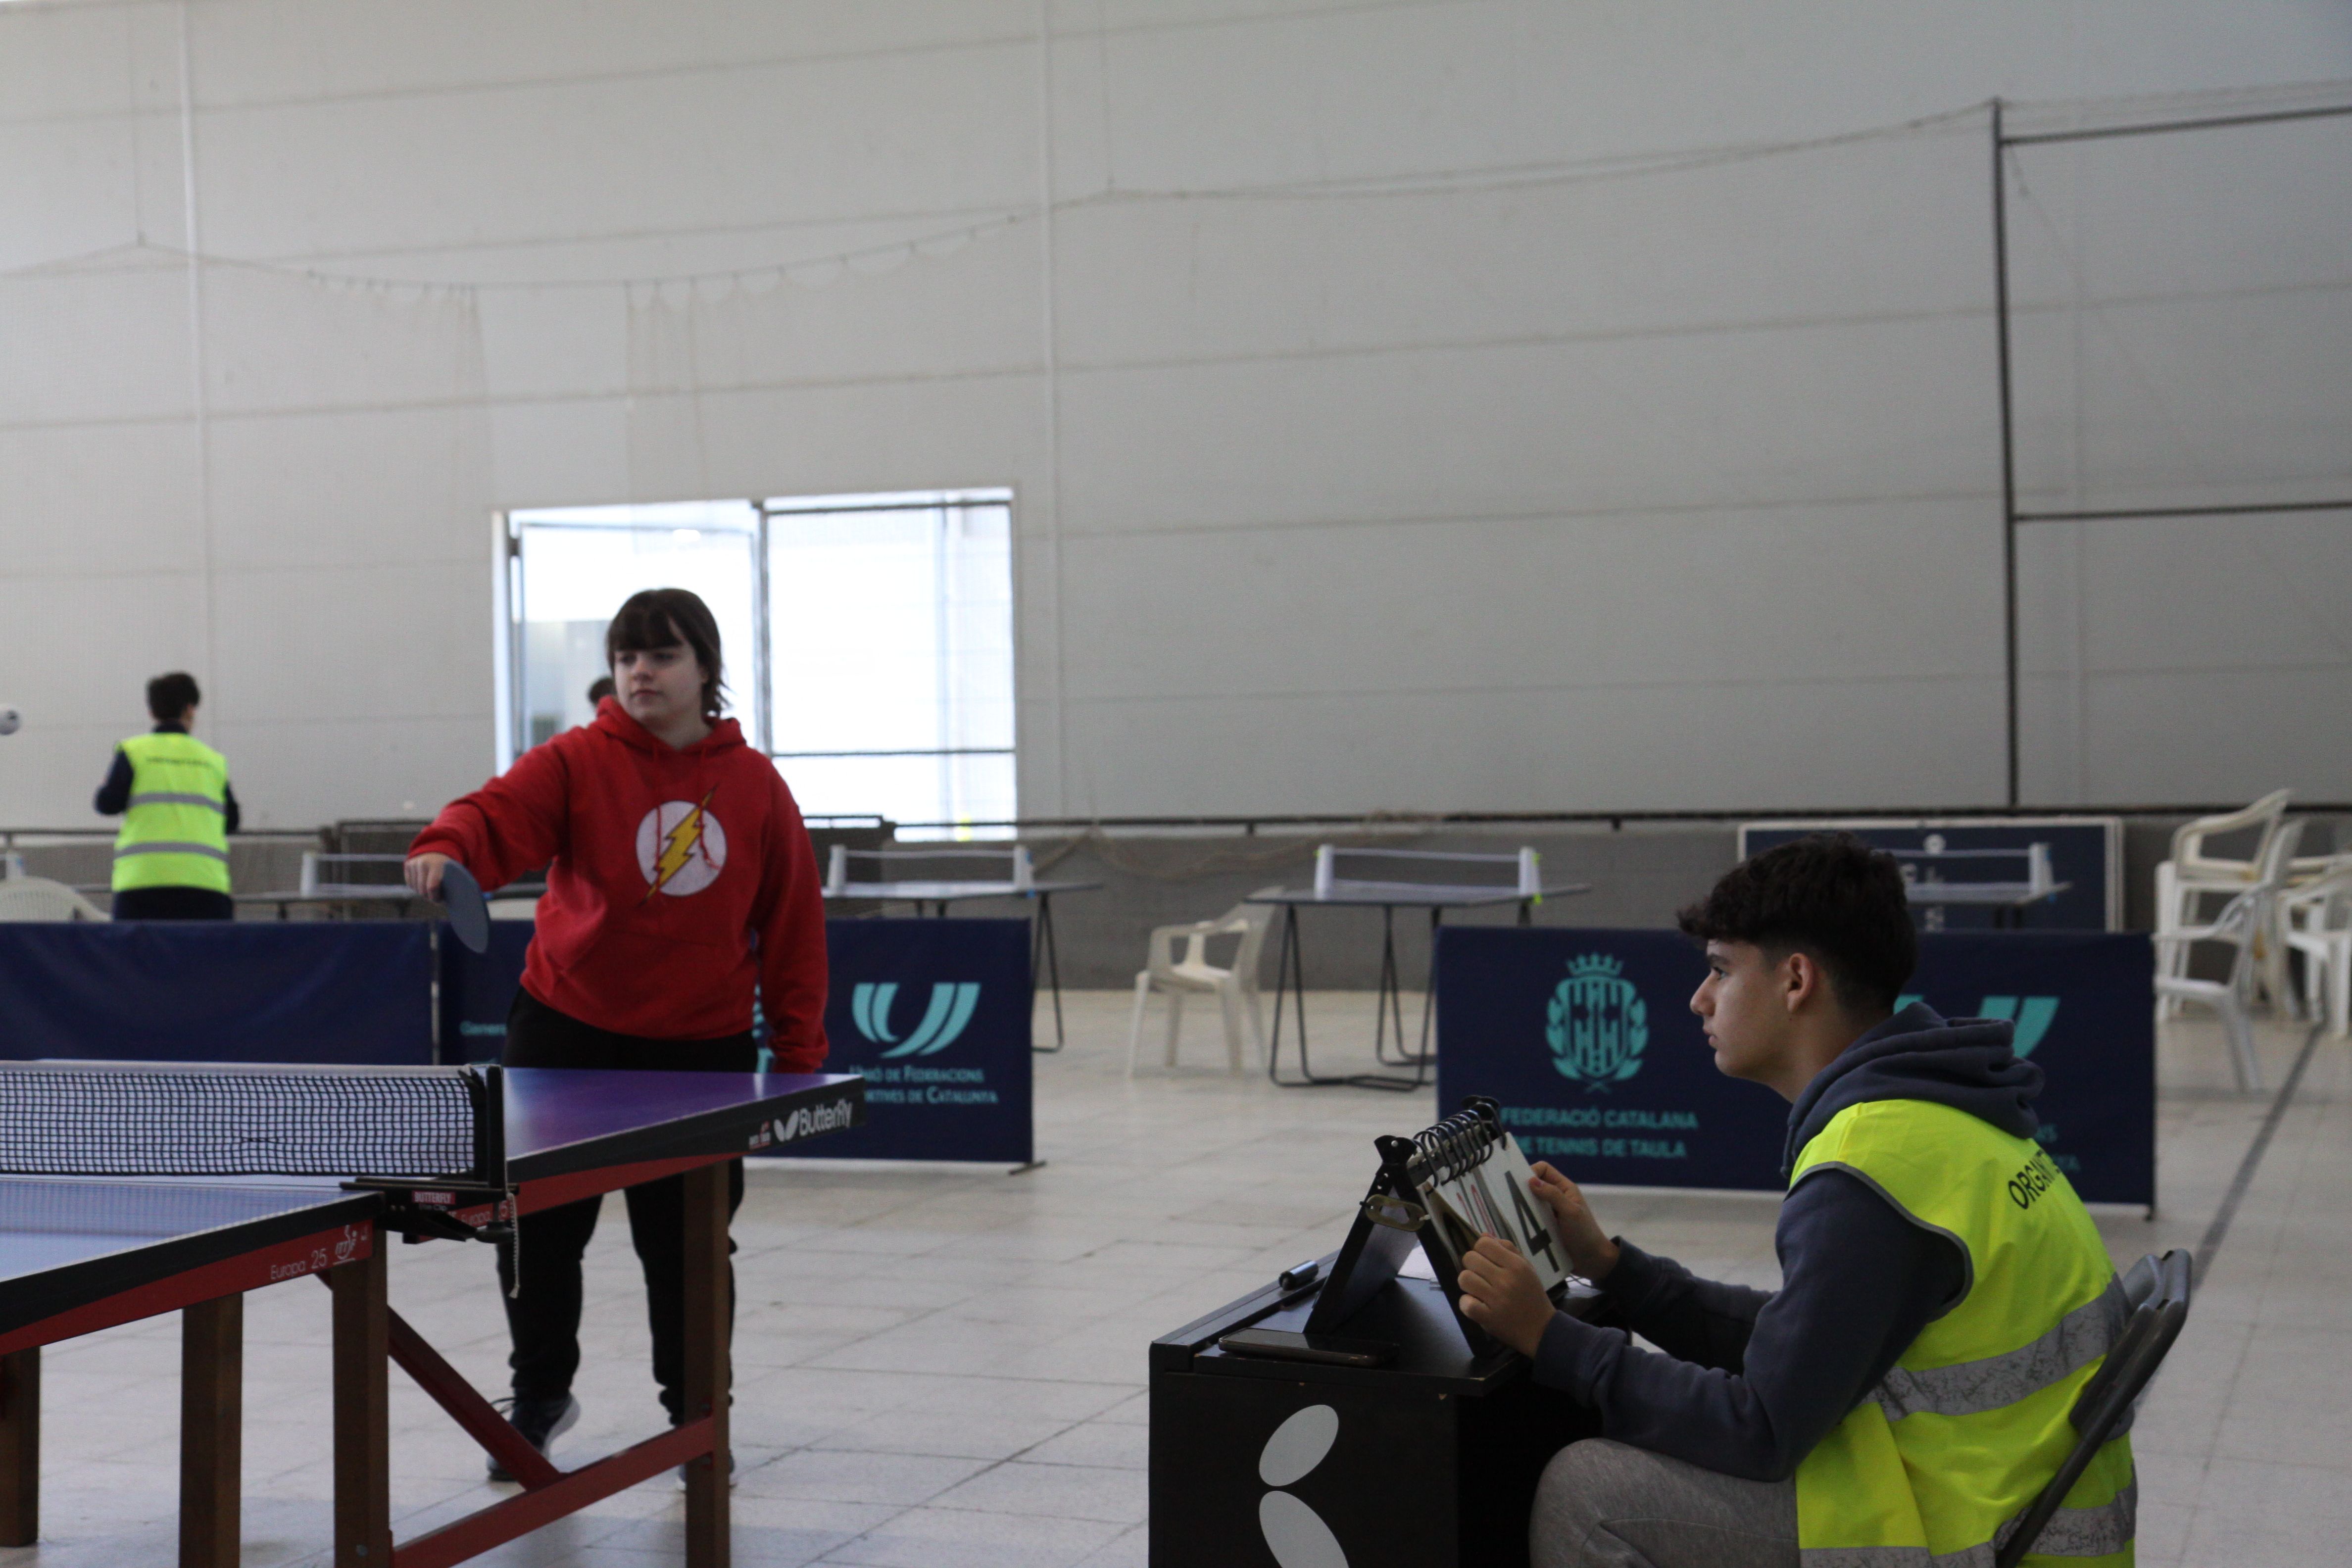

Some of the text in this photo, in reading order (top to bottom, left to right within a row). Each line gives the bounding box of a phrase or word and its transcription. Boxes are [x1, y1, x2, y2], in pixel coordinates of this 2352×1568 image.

[799, 1098, 852, 1137] Butterfly
[1500, 1105, 1698, 1129] FEDERACIÓ CATALANA
[1536, 1136, 1599, 1156] TENNIS
[1602, 1138, 1626, 1156] DE
[1630, 1138, 1686, 1158] TAULA
[414, 1191, 452, 1203] BUTTERFLY
[1505, 1170, 1560, 1273] 4
[271, 1260, 306, 1279] Europa
[311, 1248, 328, 1269] 25
